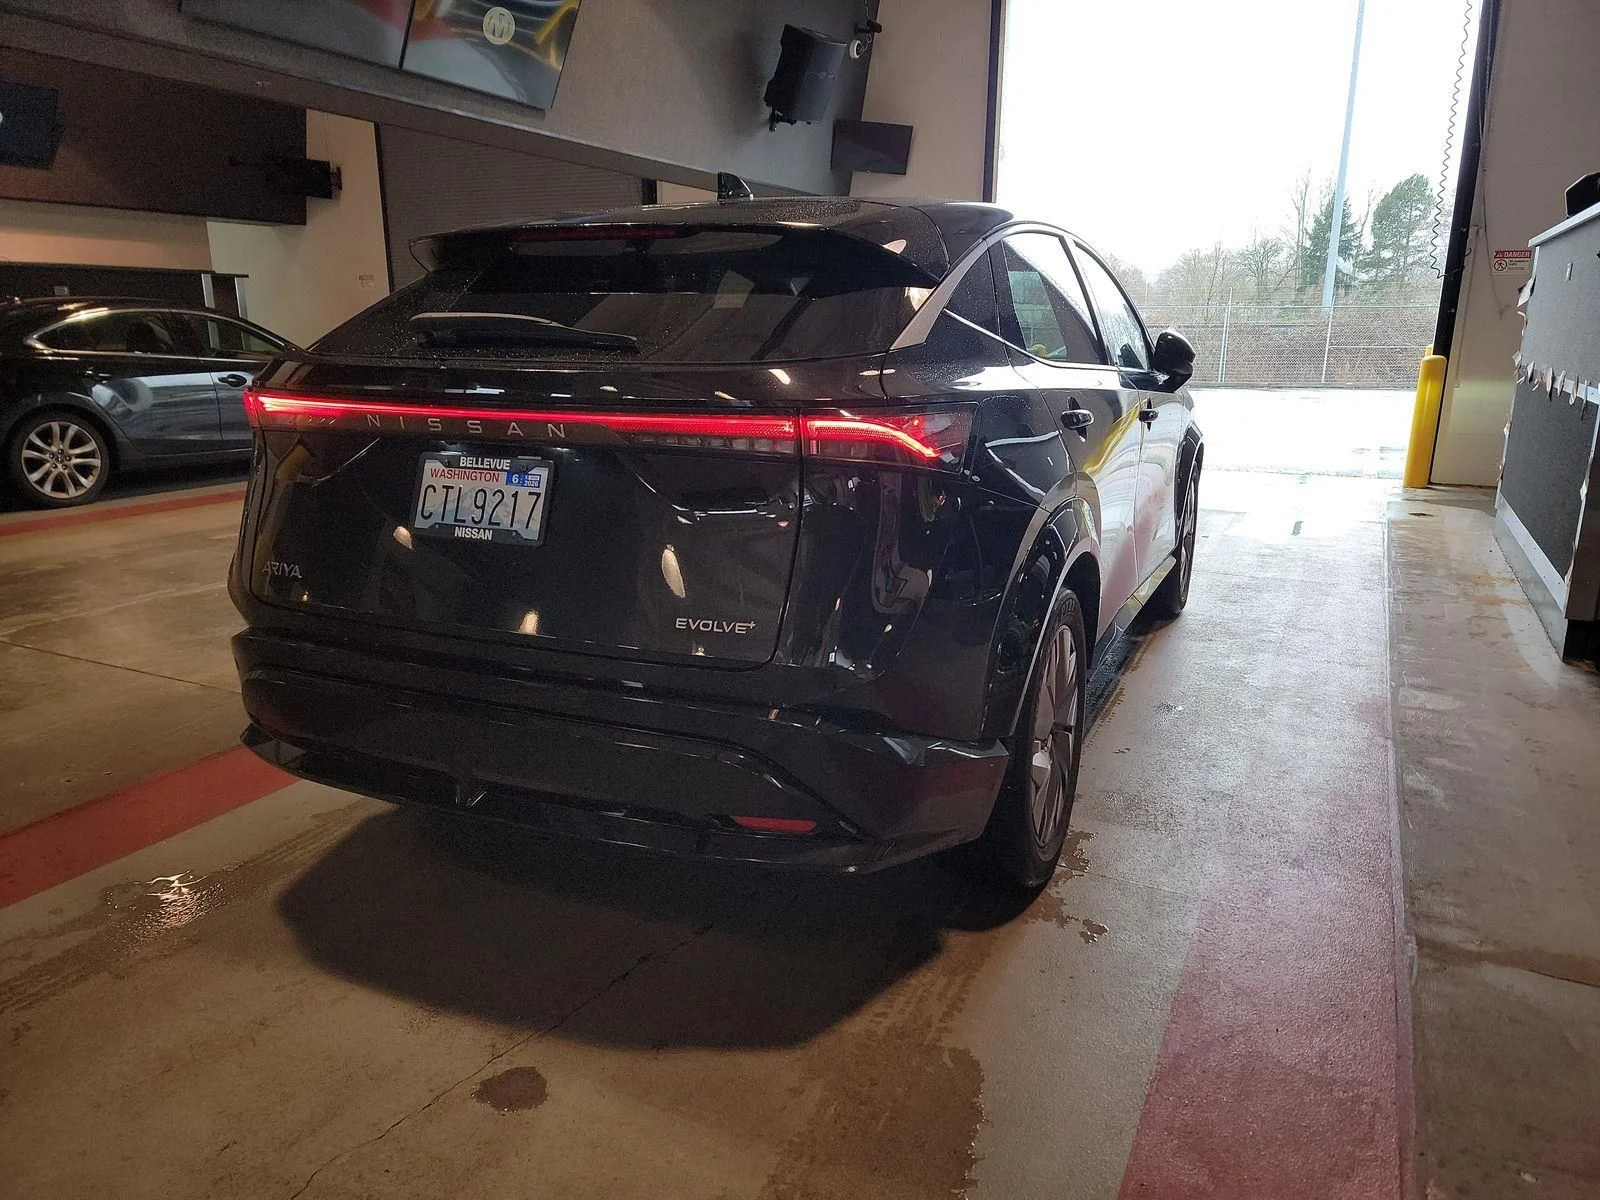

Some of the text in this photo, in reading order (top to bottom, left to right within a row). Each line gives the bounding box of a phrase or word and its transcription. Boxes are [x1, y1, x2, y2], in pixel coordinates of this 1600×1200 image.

[367, 414, 566, 438] NISSAN
[460, 456, 511, 470] BELLEVUE
[430, 468, 500, 483] WASHINGTON
[512, 474, 519, 484] 6
[420, 484, 542, 530] CTL9217
[455, 527, 493, 541] NISSAN
[261, 560, 302, 579] ARIYA
